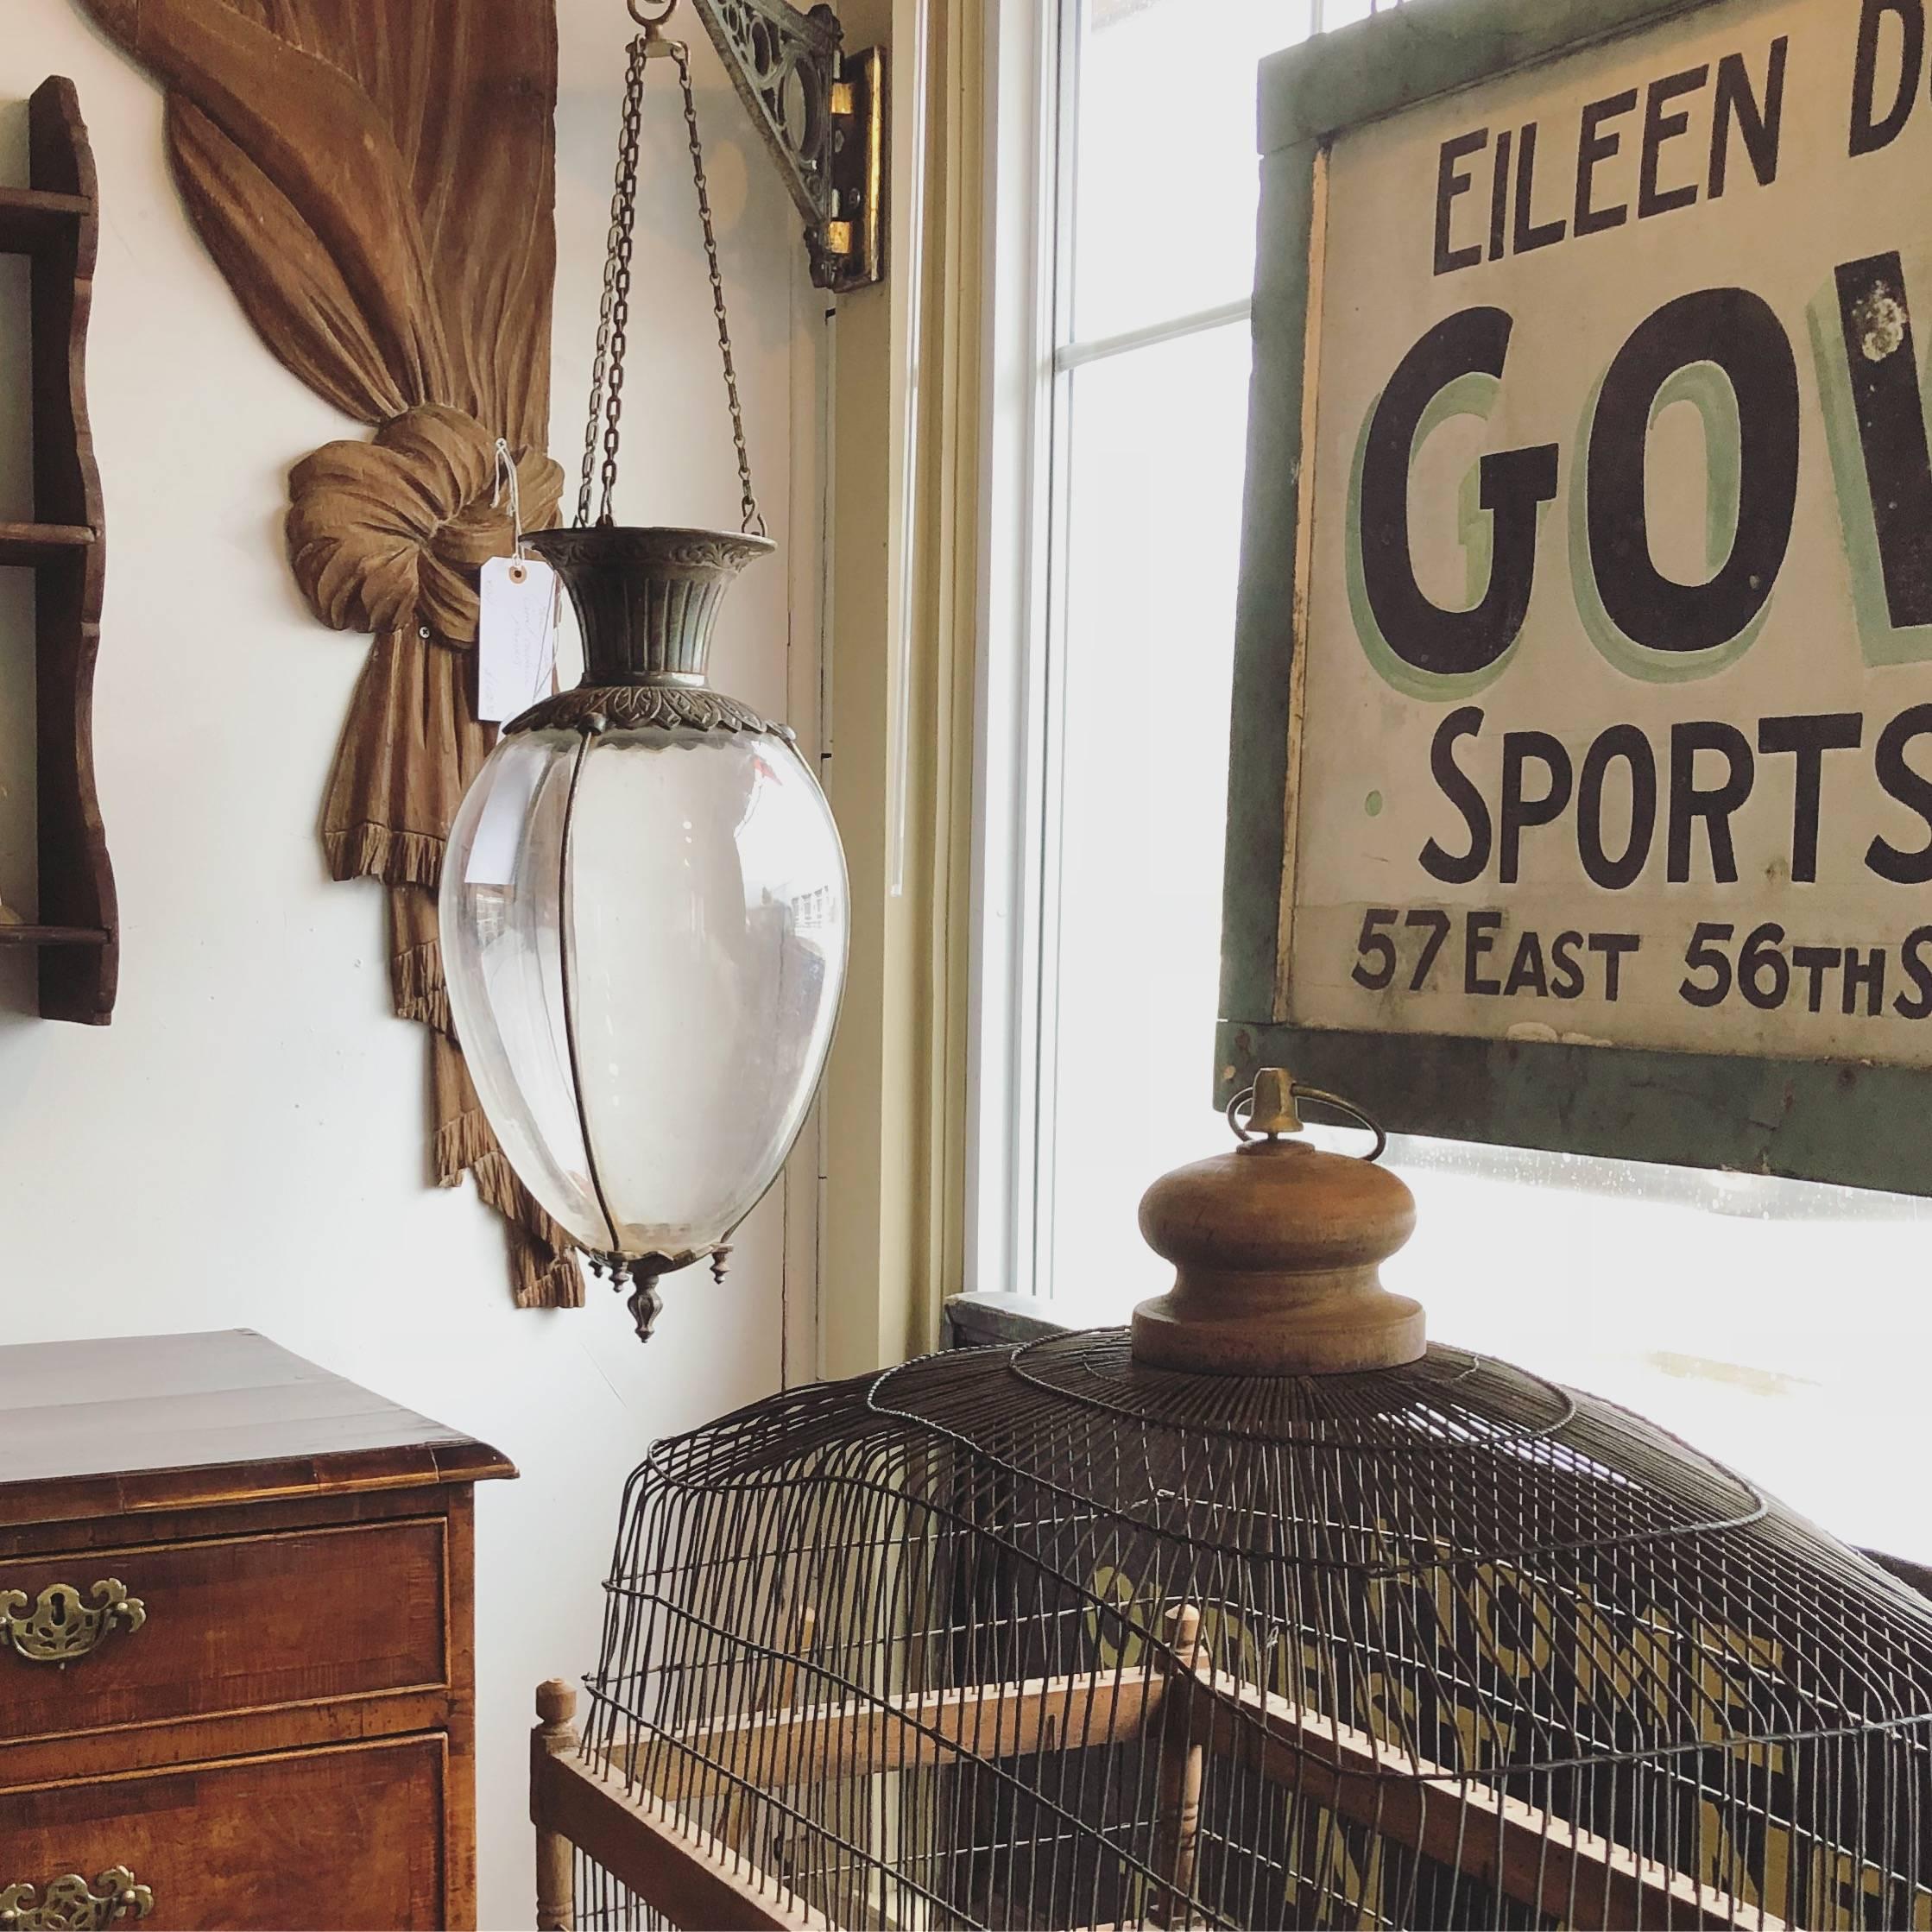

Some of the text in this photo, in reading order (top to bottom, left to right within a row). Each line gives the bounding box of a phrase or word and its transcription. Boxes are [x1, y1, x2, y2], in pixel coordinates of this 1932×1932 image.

[1433, 35, 1789, 277] EILEEN
[1417, 702, 1932, 890] SPORTS
[1351, 908, 1451, 991] 57
[1464, 911, 1640, 1001] EAST
[1368, 1518, 1784, 1775] HOME
